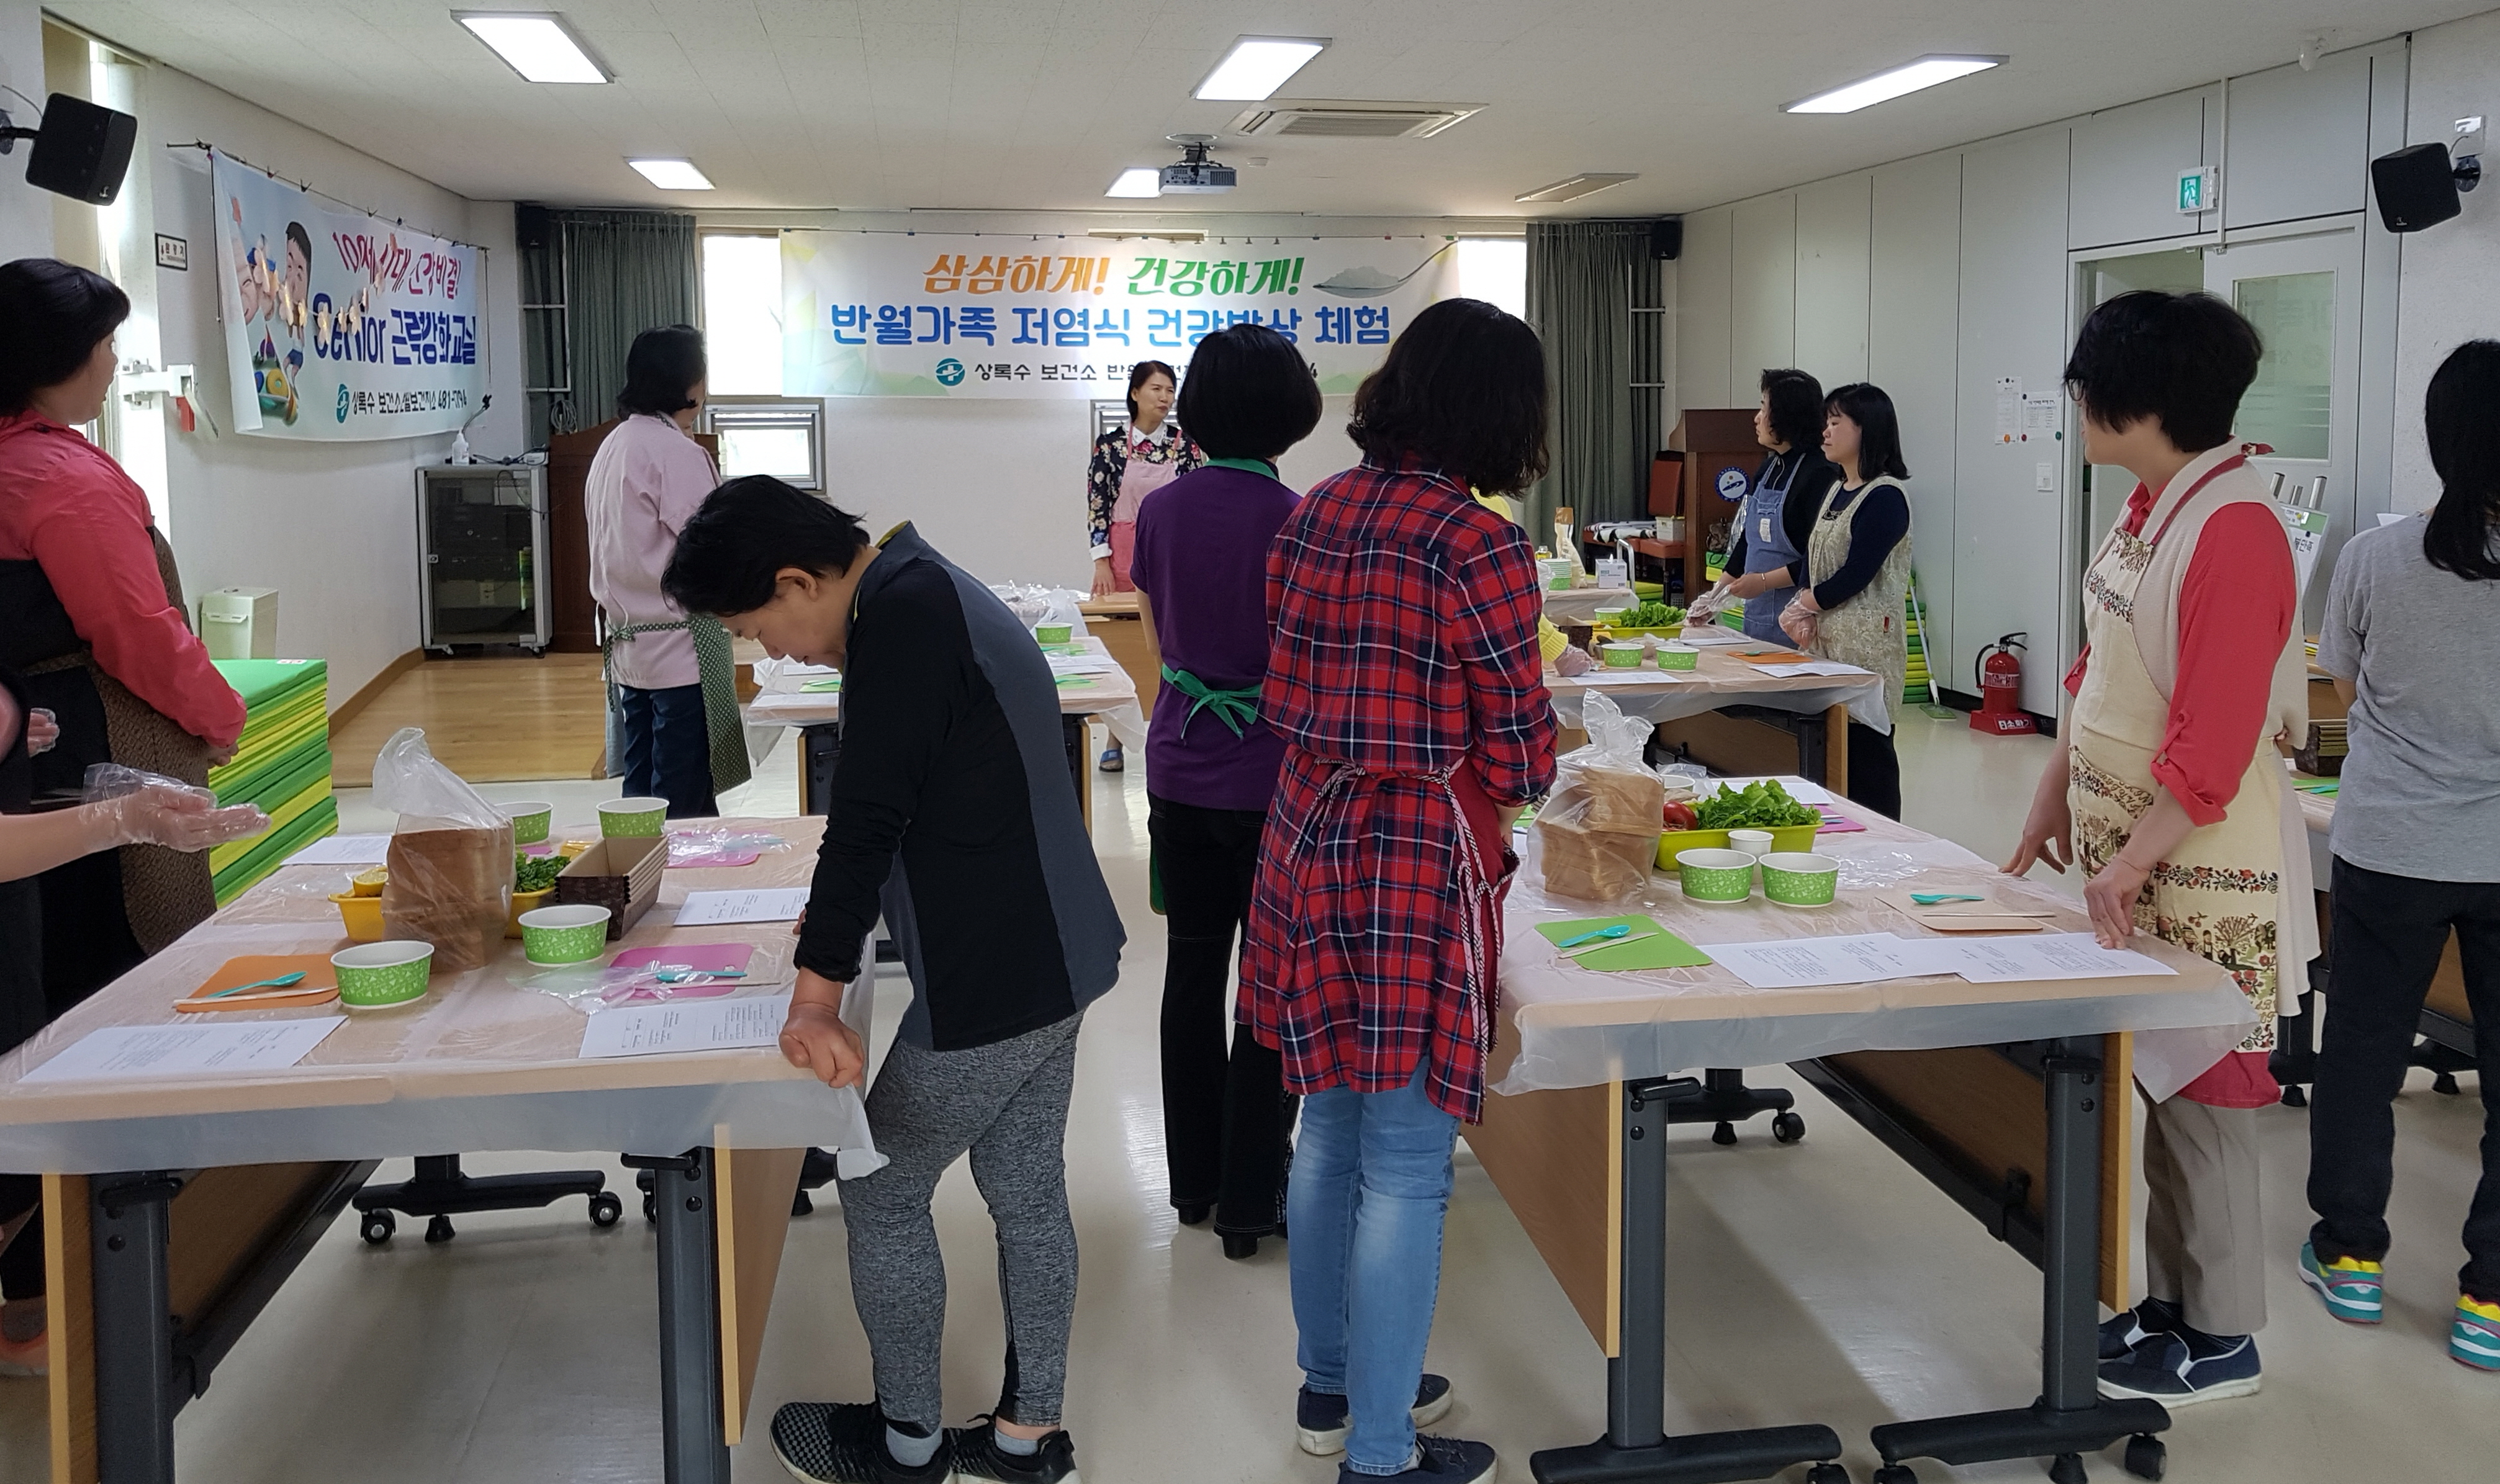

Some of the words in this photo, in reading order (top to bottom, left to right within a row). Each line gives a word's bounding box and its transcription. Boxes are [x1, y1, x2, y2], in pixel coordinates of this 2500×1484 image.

[923, 254, 1111, 295] 삼삼하게!
[1127, 257, 1305, 297] 건강하게!
[831, 304, 998, 347] 반월가족
[1011, 307, 1130, 348] 저염식
[1314, 305, 1391, 345] 체험
[974, 363, 1032, 382] 상록수
[1040, 364, 1097, 380] 보건소
[352, 390, 375, 415] 상록수
